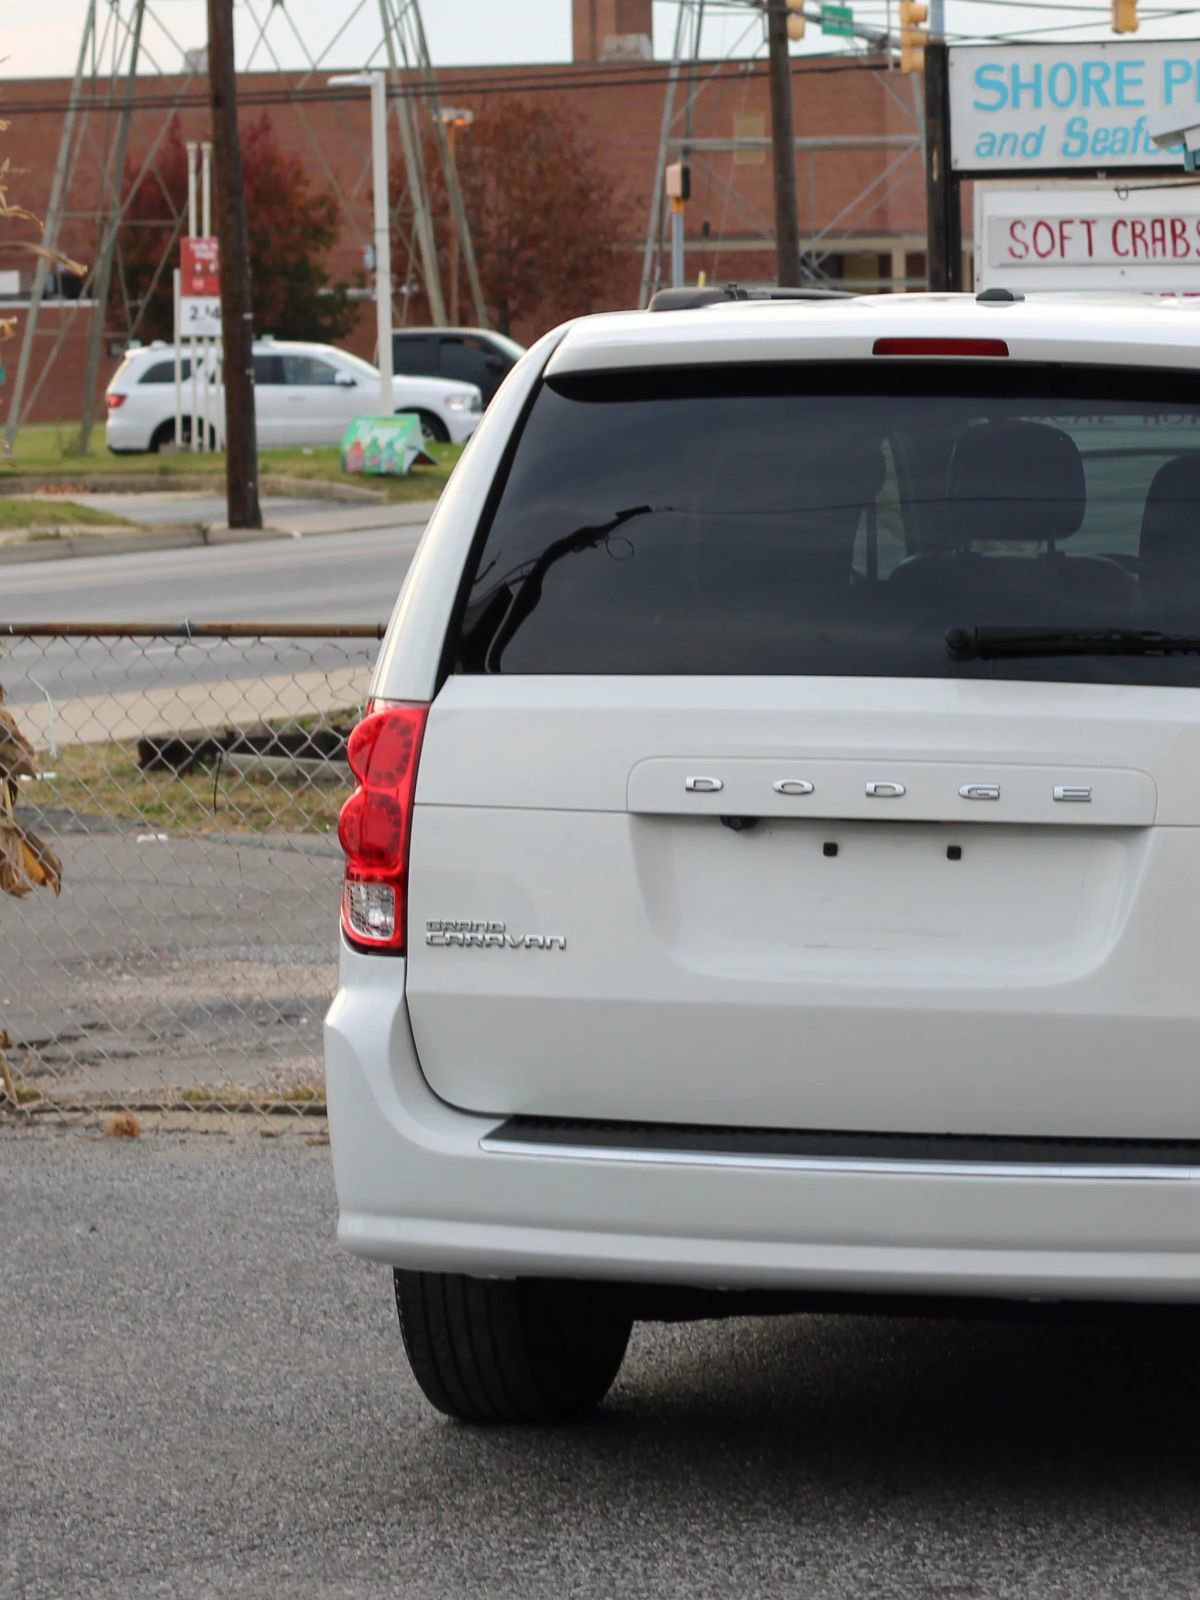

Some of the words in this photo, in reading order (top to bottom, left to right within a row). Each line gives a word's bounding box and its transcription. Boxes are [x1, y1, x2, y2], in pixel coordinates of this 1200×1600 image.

[973, 59, 1145, 112] SHORE
[975, 125, 1045, 158] and
[1008, 219, 1096, 259] SOFT
[685, 776, 1093, 802] DODGE
[426, 920, 506, 932] GRAND
[426, 932, 567, 950] CARAVAN
